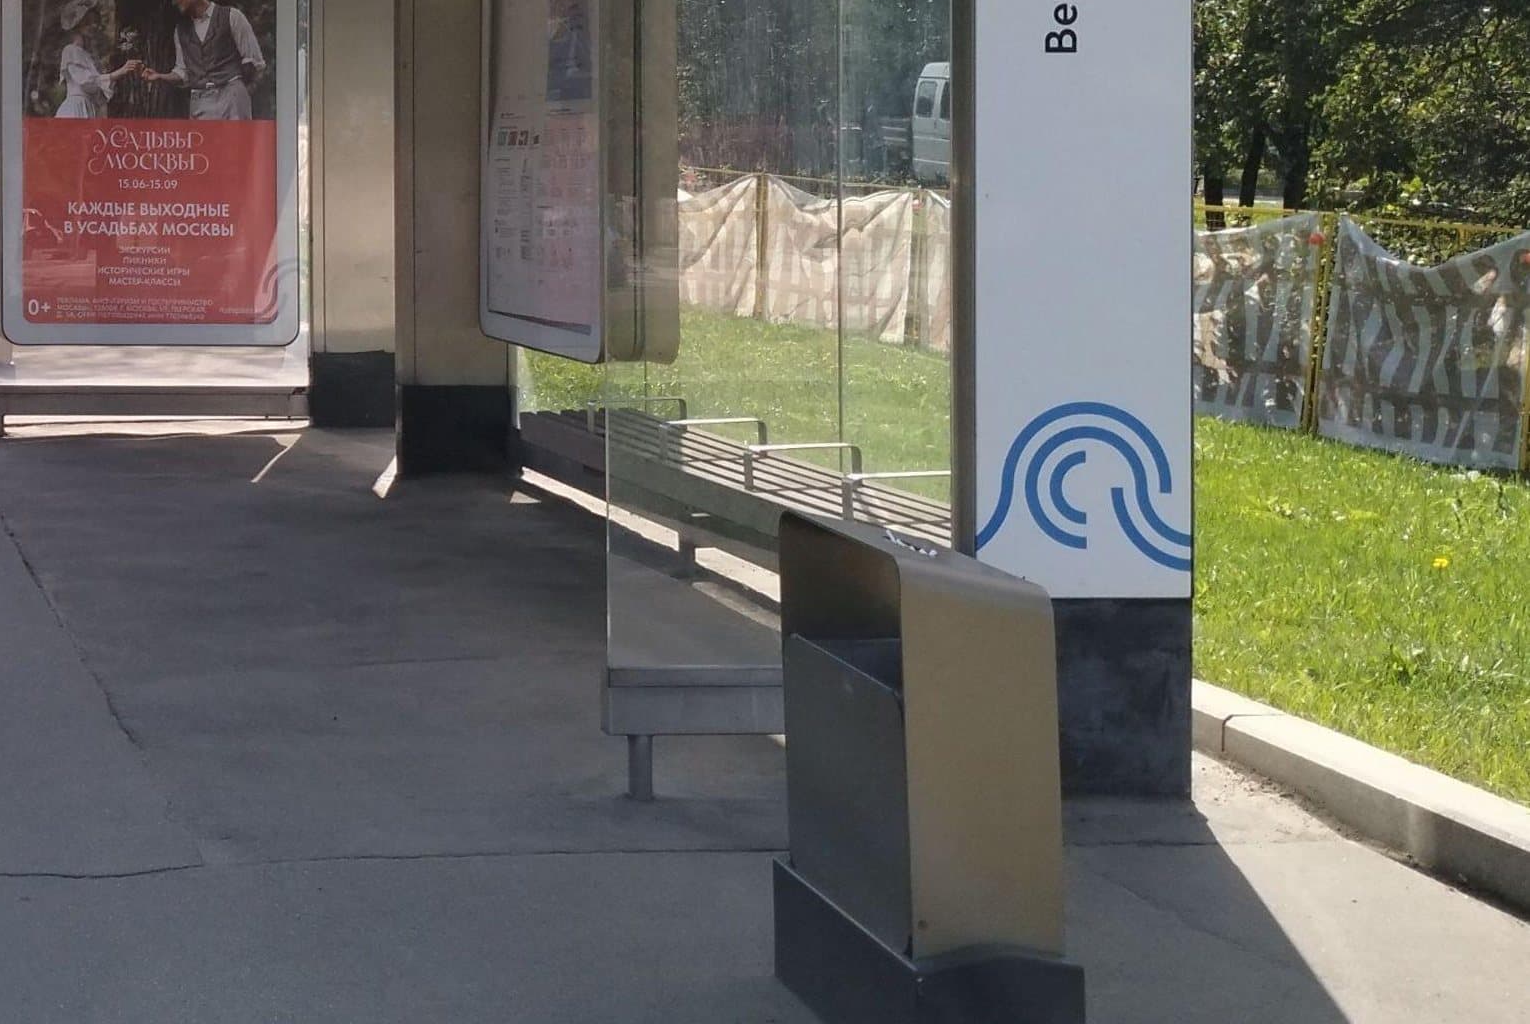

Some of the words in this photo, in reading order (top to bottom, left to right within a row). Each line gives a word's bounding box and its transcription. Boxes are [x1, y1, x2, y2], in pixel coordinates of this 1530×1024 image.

[93, 124, 204, 152] УСАДЬБЫ
[87, 152, 209, 175] МОСКВЫ
[118, 179, 178, 190] 15.06-15.09
[67, 201, 135, 217] КАЖДЫЕ
[140, 202, 230, 218] ВЫХОДНЫЕ
[64, 221, 73, 235] В
[77, 221, 158, 237] УСАДЬБАХ
[162, 222, 234, 237] МОСКВЫ
[27, 298, 51, 316] 0+
